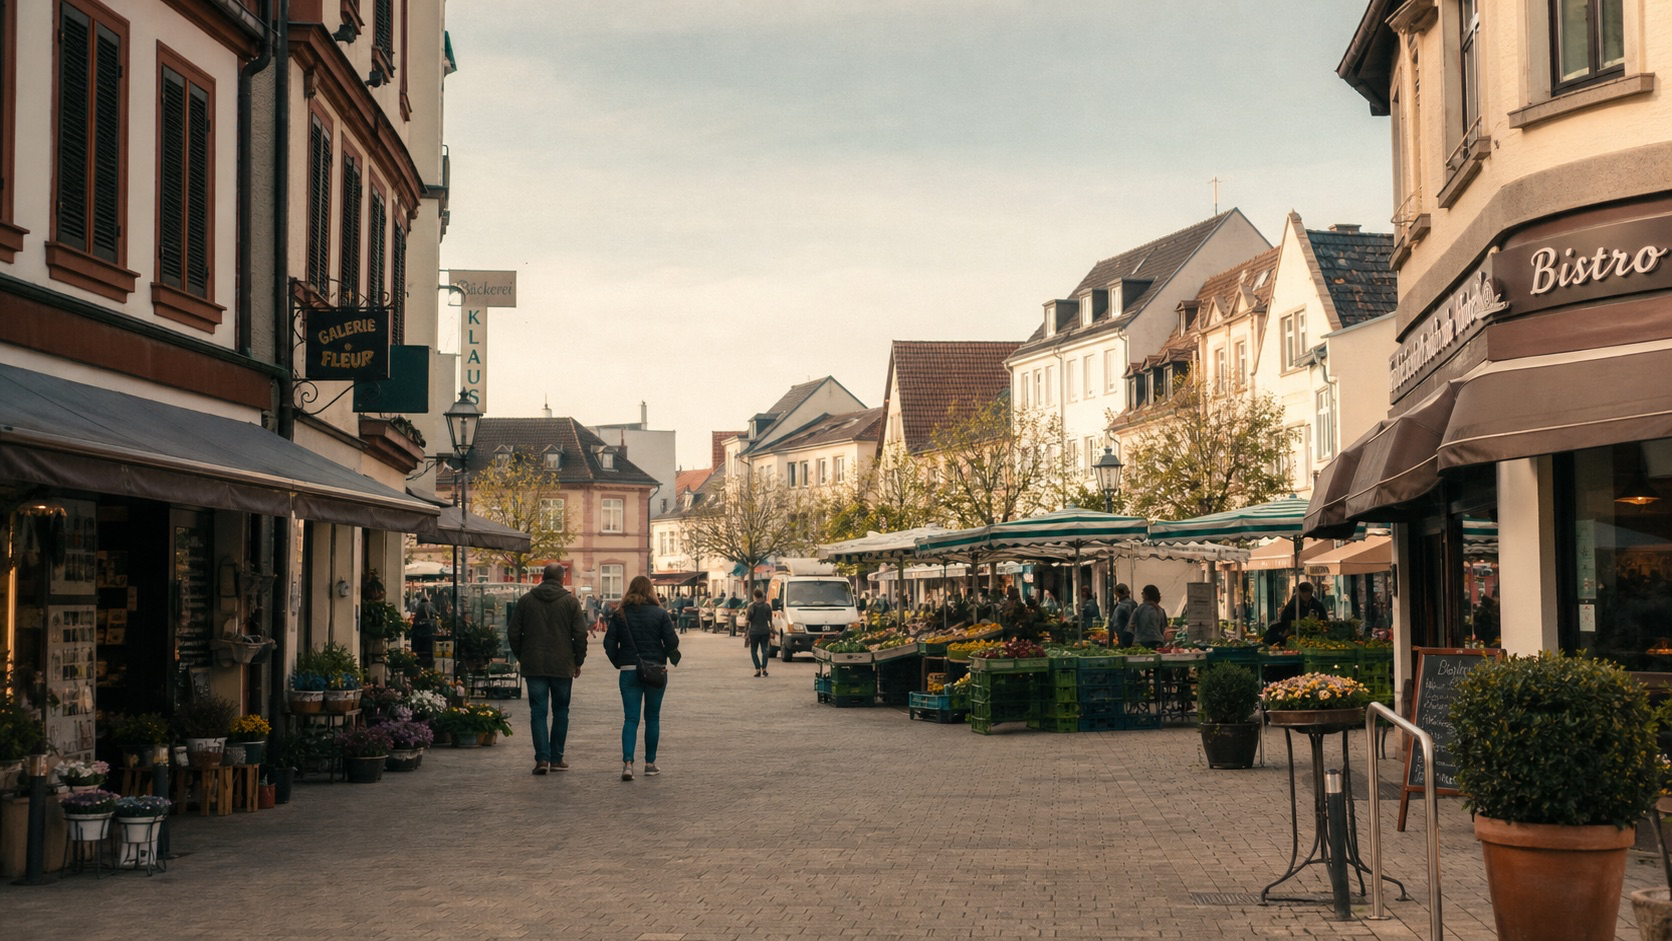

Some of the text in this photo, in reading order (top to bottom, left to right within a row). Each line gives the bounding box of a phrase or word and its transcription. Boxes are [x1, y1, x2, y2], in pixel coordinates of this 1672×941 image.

[1530, 245, 1667, 295] Bistro
[318, 318, 377, 345] GALERIE
[321, 350, 375, 369] FLEUR
[467, 309, 481, 405] KLAUS
